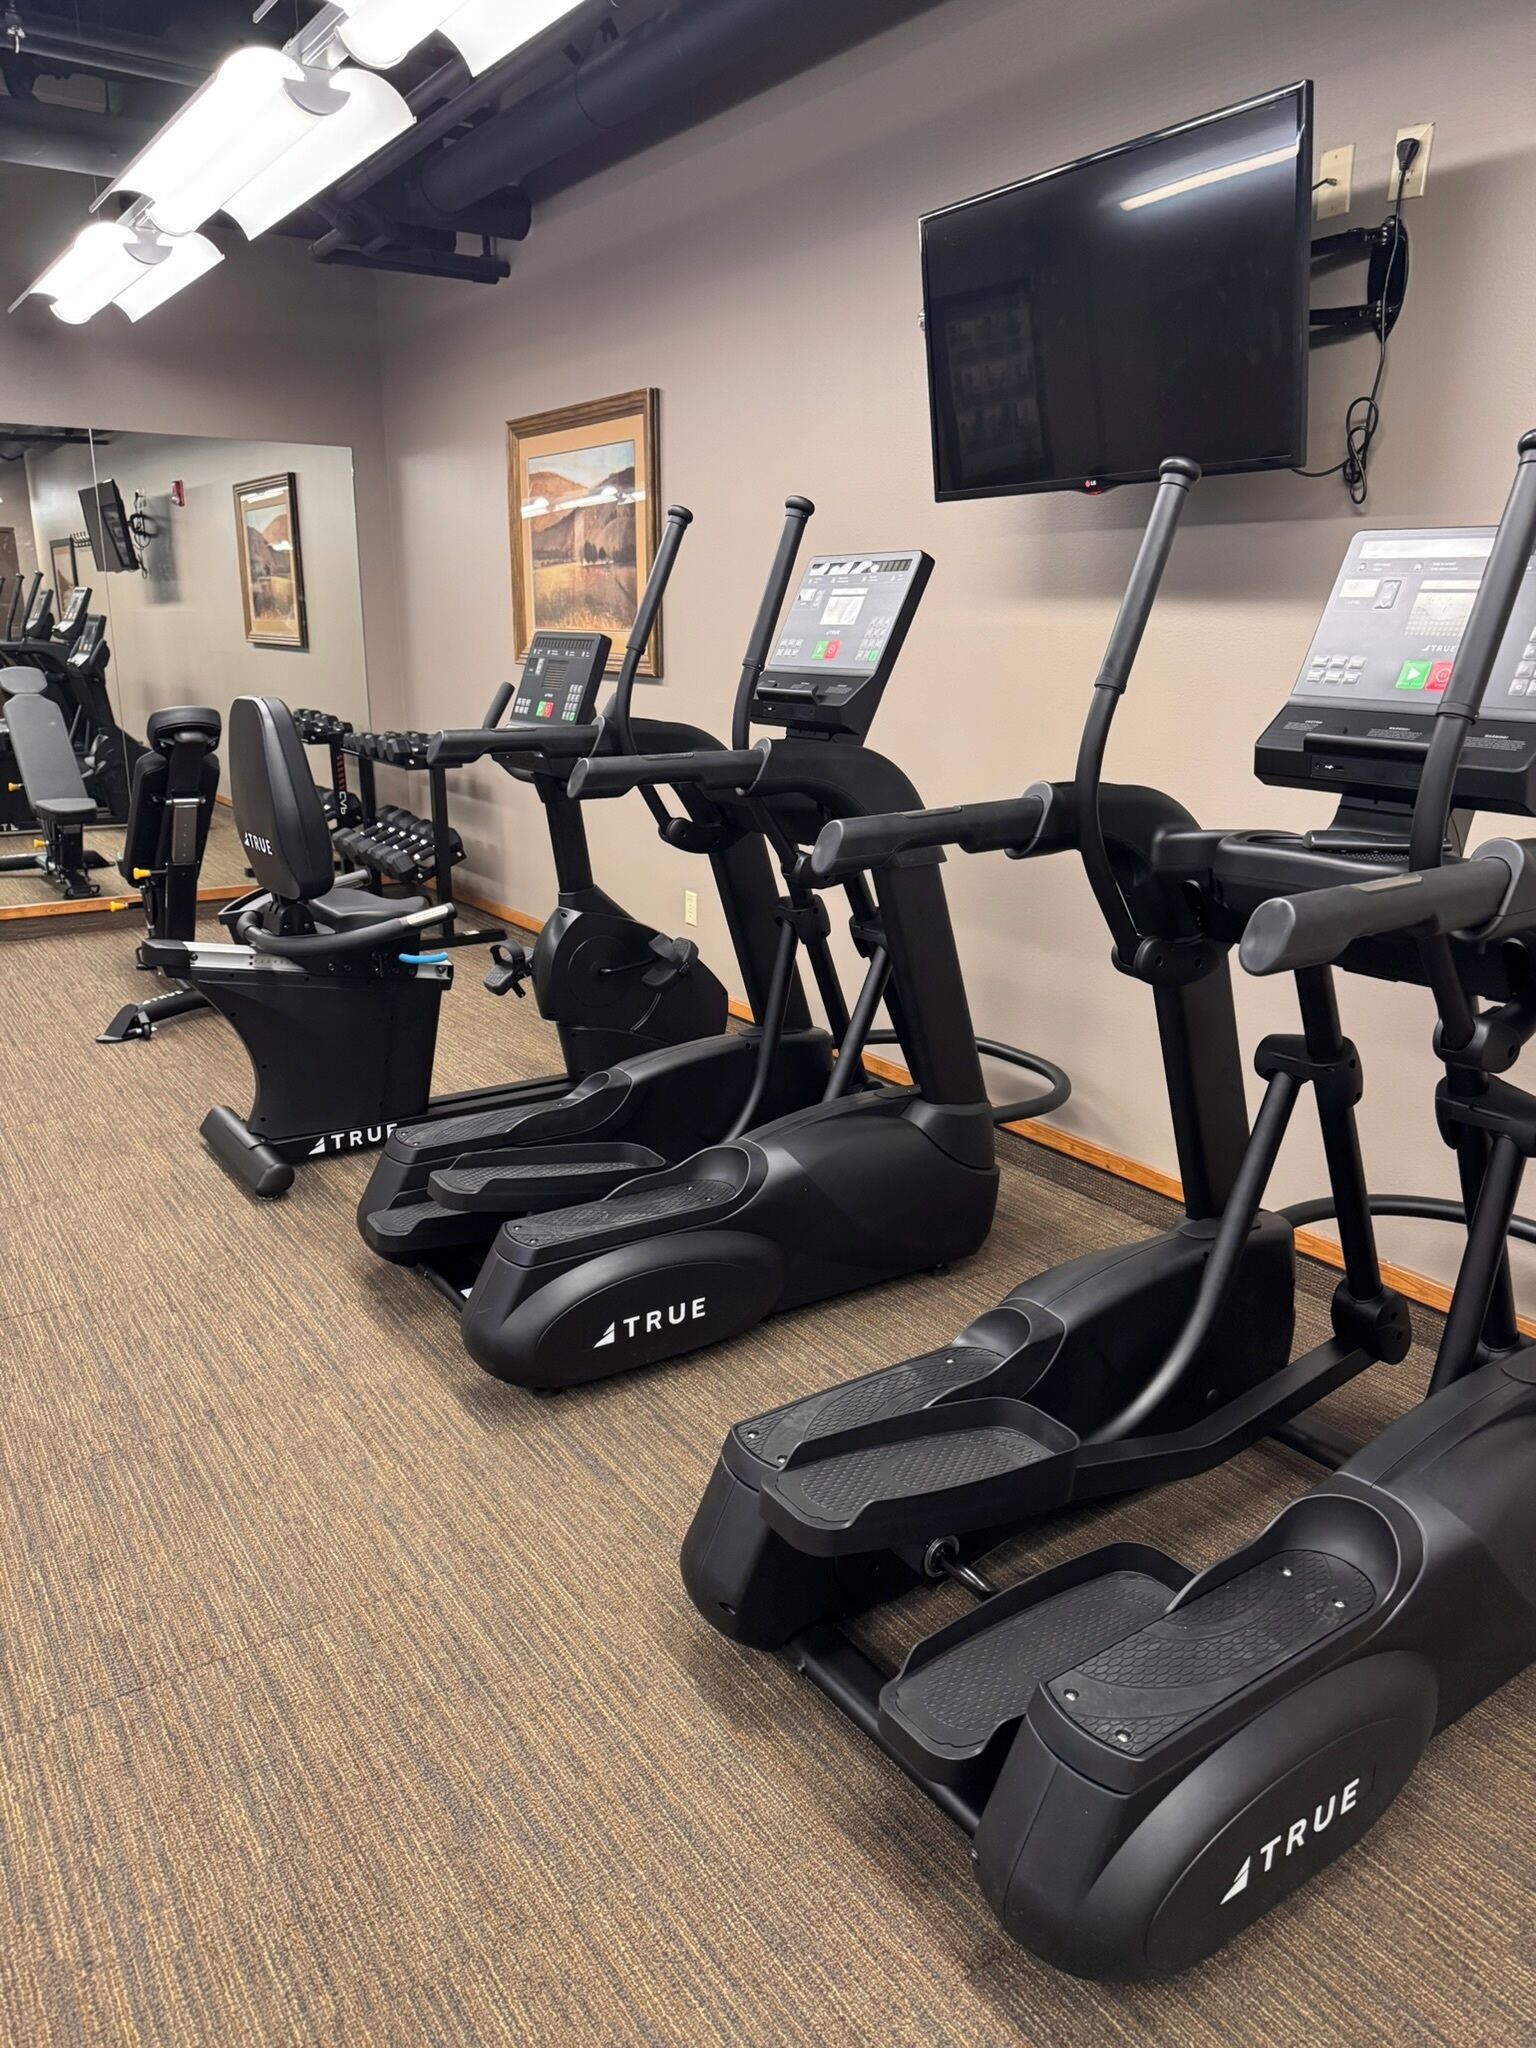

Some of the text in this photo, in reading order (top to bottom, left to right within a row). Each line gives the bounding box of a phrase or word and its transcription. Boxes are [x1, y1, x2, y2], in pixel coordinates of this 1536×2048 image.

[247, 832, 273, 856] TRUE
[622, 1296, 706, 1338] TRUE
[1260, 1777, 1360, 1873] TRUE
